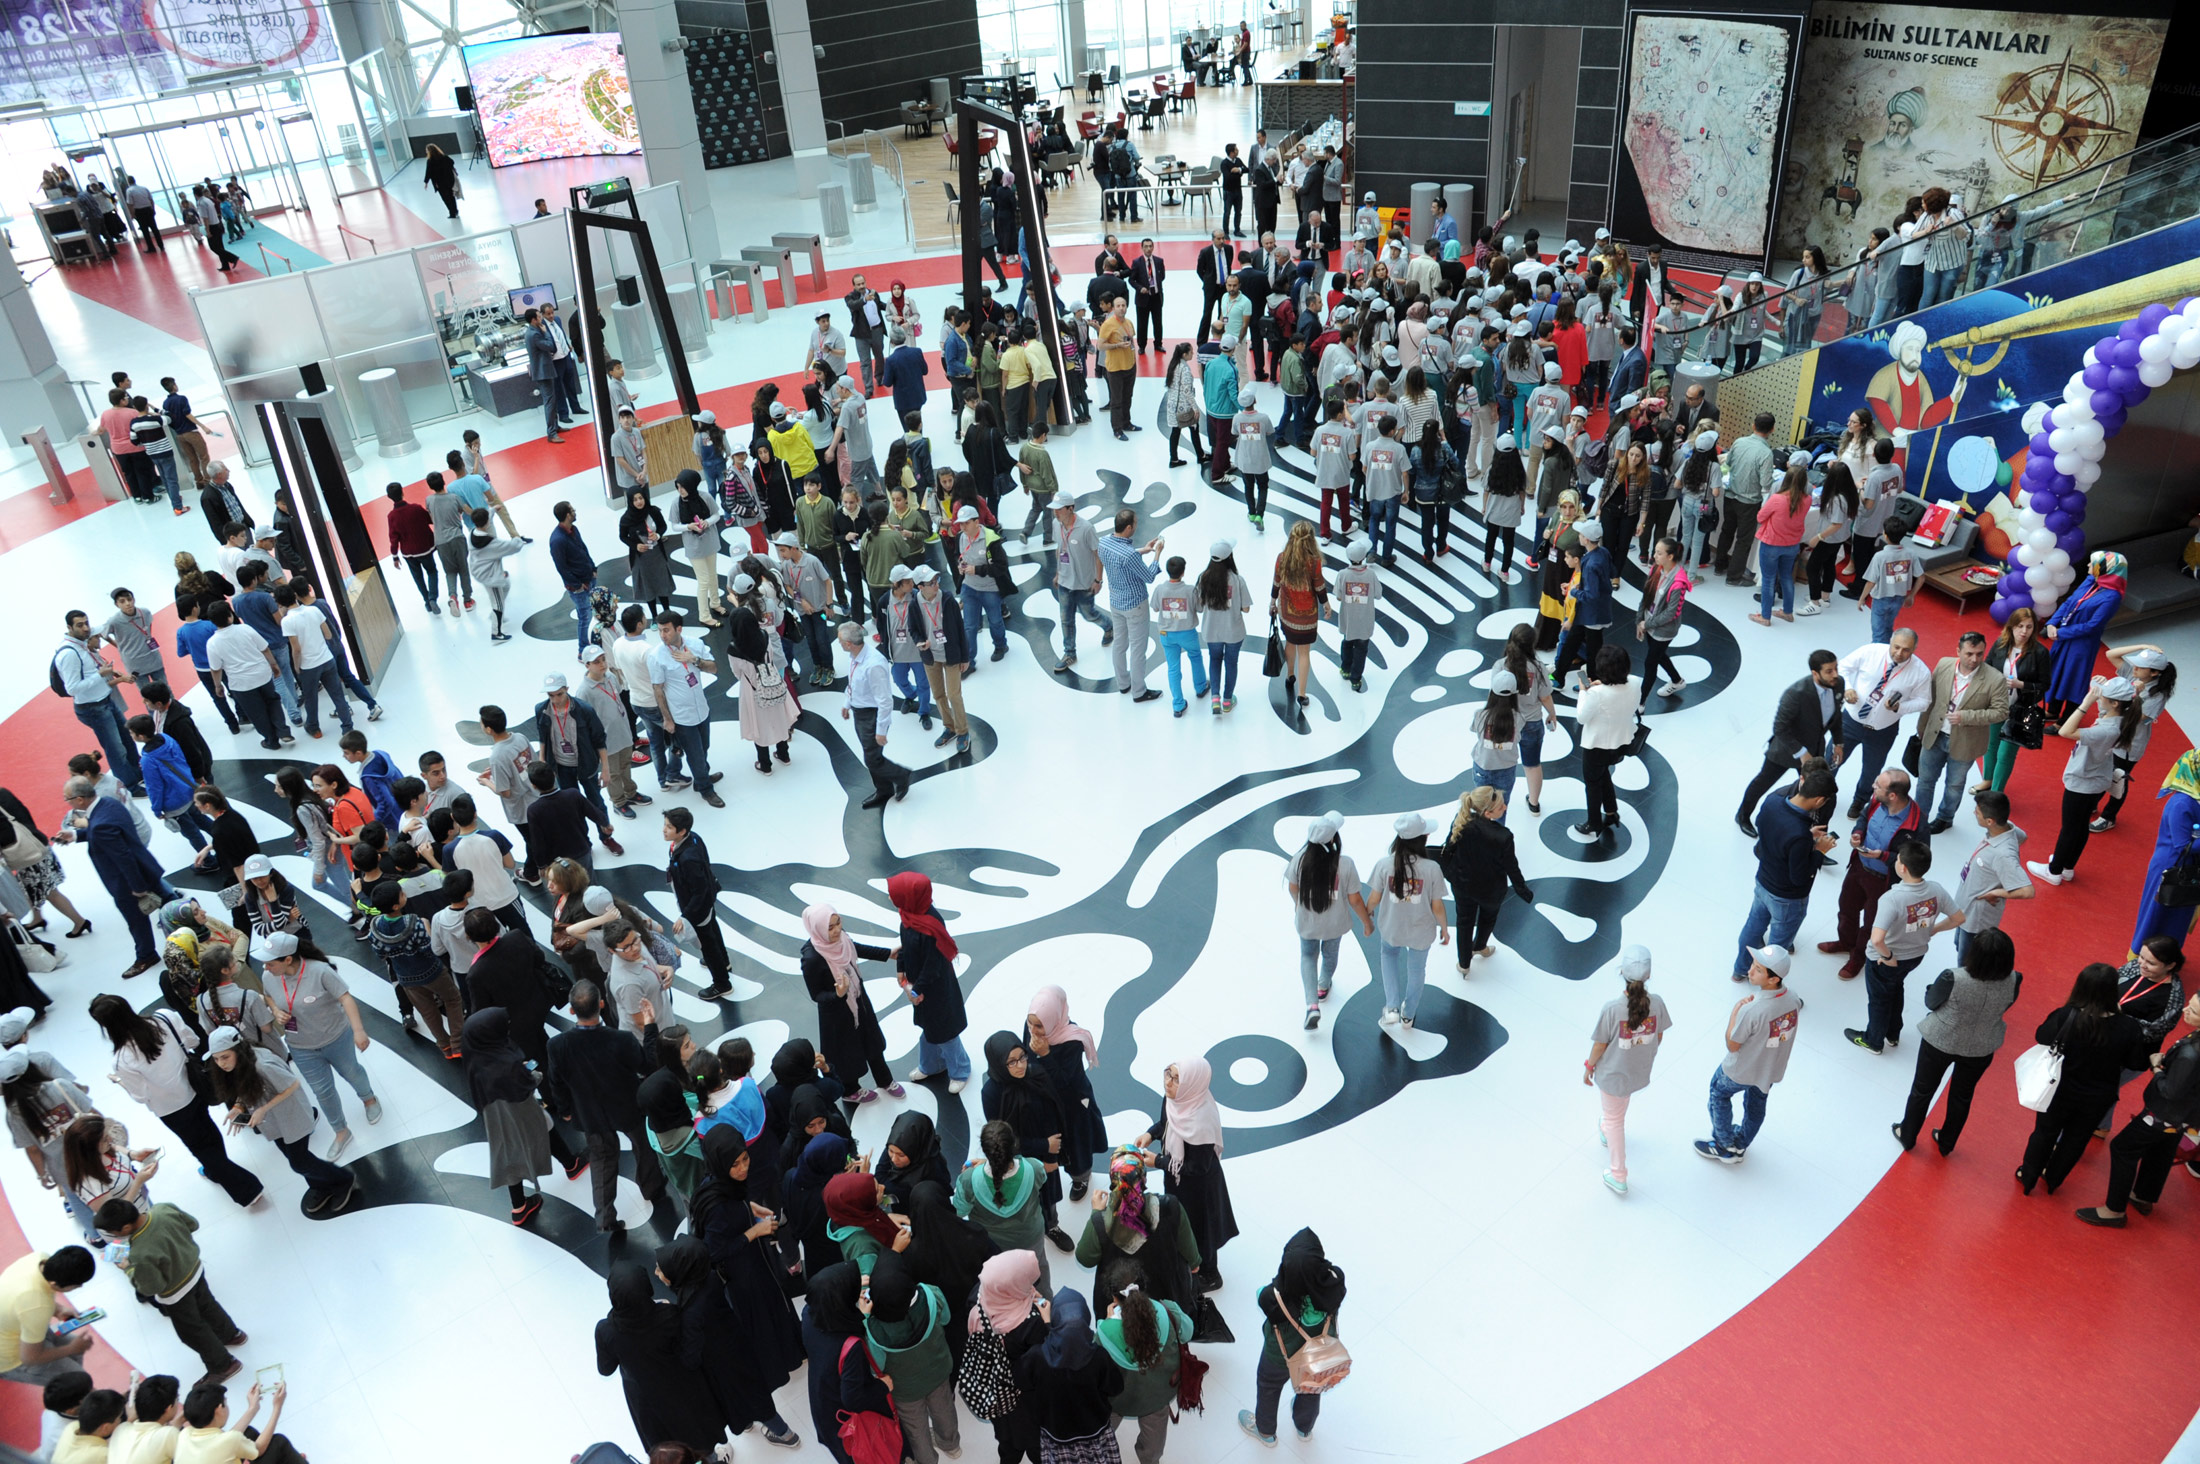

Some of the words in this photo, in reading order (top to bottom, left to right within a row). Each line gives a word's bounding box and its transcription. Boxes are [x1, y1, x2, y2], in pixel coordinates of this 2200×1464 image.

[1810, 15, 1895, 43] BİLİMİN
[1903, 25, 2051, 55] SULTANLARI
[1863, 48, 1911, 62] SULTANS
[1913, 52, 1929, 64] OF
[1931, 54, 1979, 68] SCIENCE
